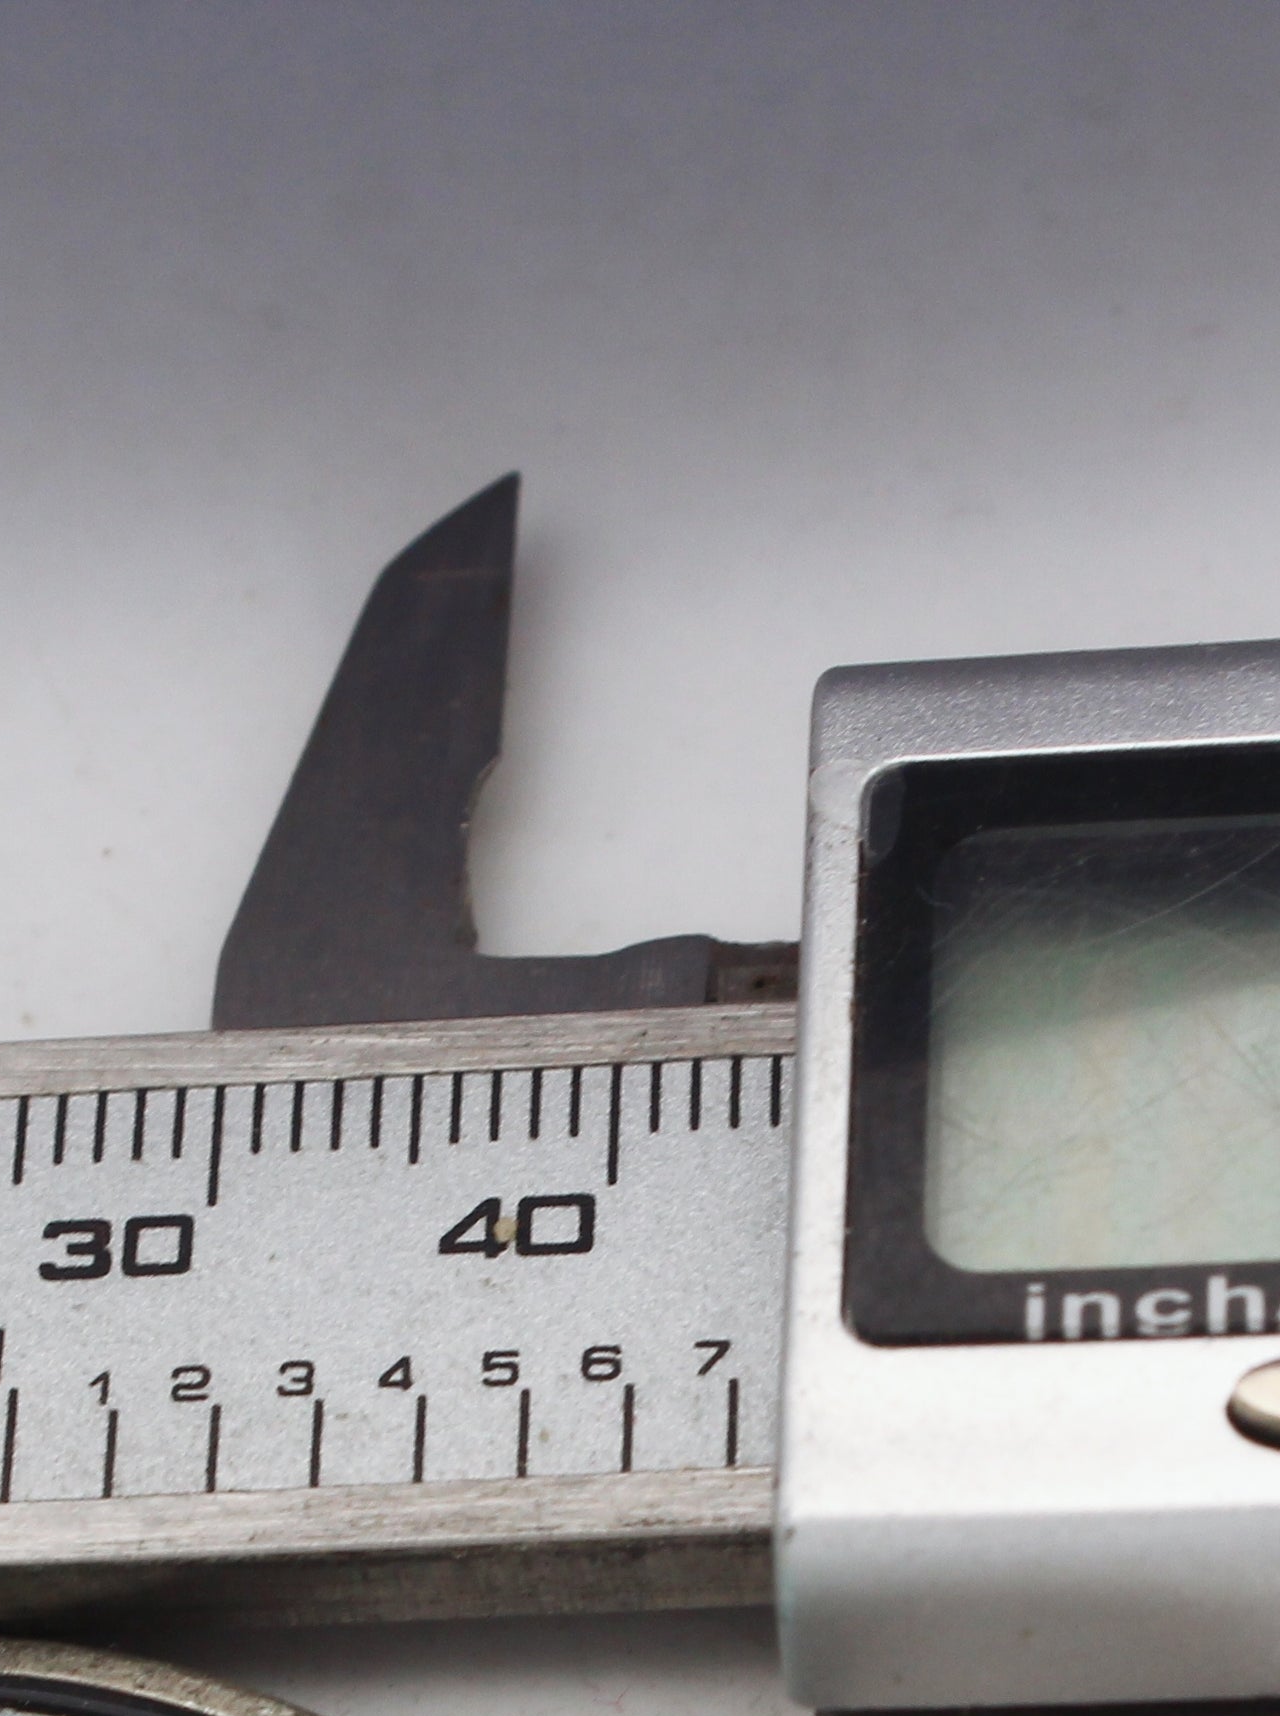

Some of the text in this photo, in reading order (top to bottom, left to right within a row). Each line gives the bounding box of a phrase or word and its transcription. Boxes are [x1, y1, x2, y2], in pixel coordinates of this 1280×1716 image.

[38, 1214, 195, 1282] 30
[438, 1192, 597, 1259] 40
[88, 1370, 111, 1405] 1
[170, 1365, 212, 1403] 2
[276, 1360, 316, 1397] 3
[377, 1356, 414, 1391] 4
[482, 1350, 520, 1388] 5
[580, 1345, 623, 1383] 6
[694, 1339, 731, 1376] 7
